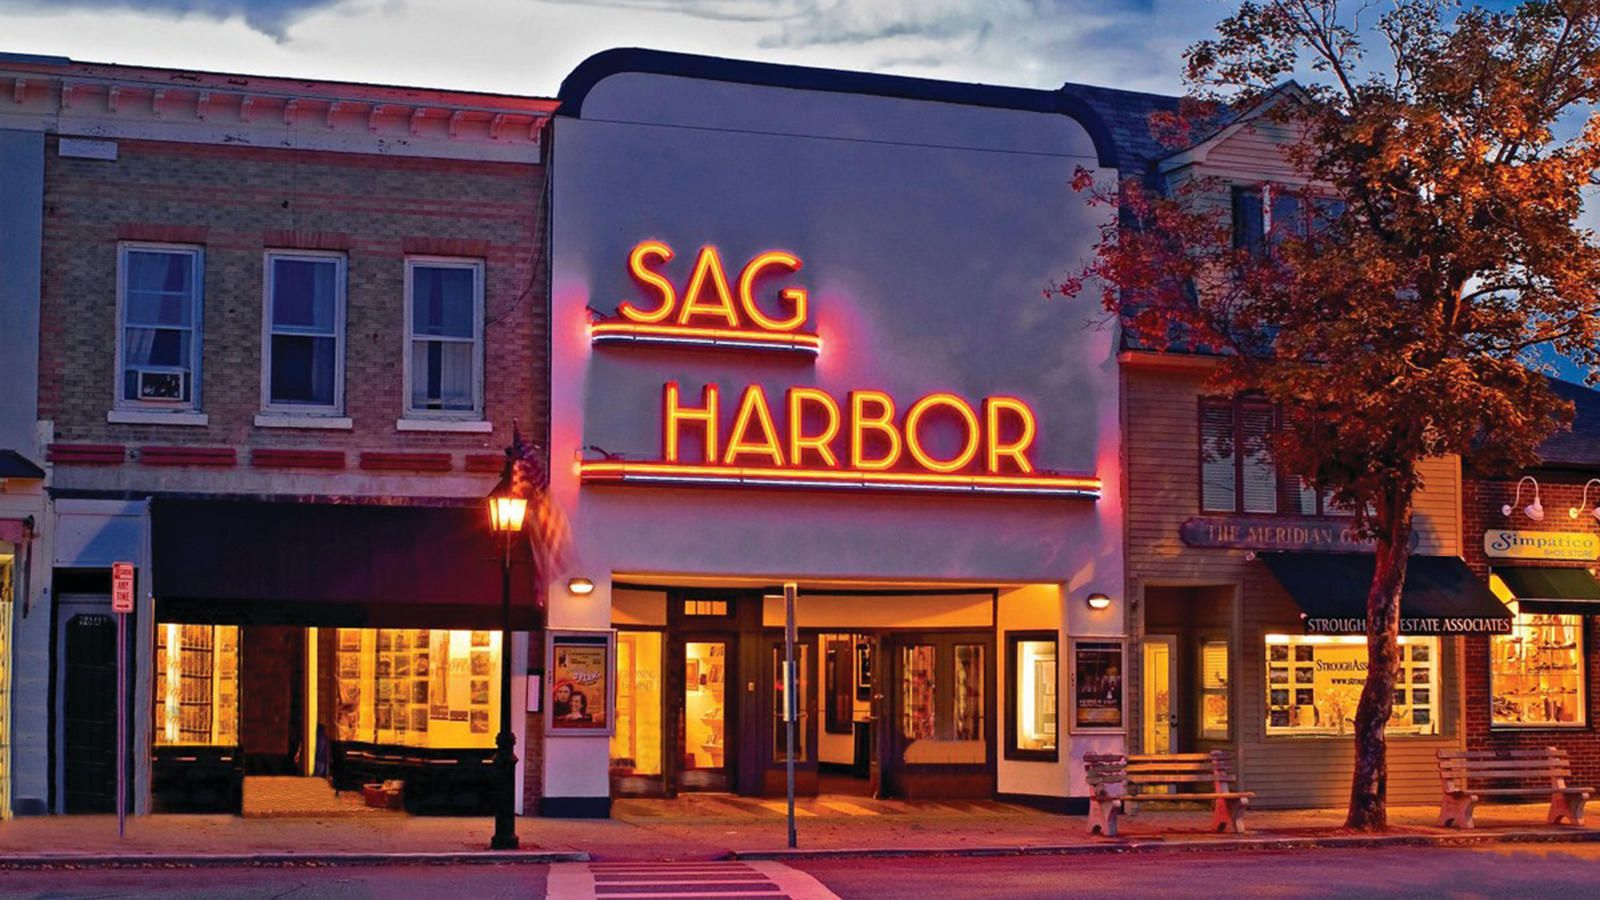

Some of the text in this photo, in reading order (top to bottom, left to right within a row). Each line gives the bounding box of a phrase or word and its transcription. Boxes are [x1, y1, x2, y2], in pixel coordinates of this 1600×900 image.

[617, 240, 808, 331] SAG
[663, 381, 1037, 474] HARBOR
[1206, 524, 1241, 542] THE
[1249, 526, 1334, 545] MERIDIAN
[1491, 532, 1593, 551] Simpatico
[118, 581, 129, 590] ANY
[116, 592, 130, 601] TIME
[1307, 618, 1511, 632] STROUGH ESTATE ASSOCIATES
